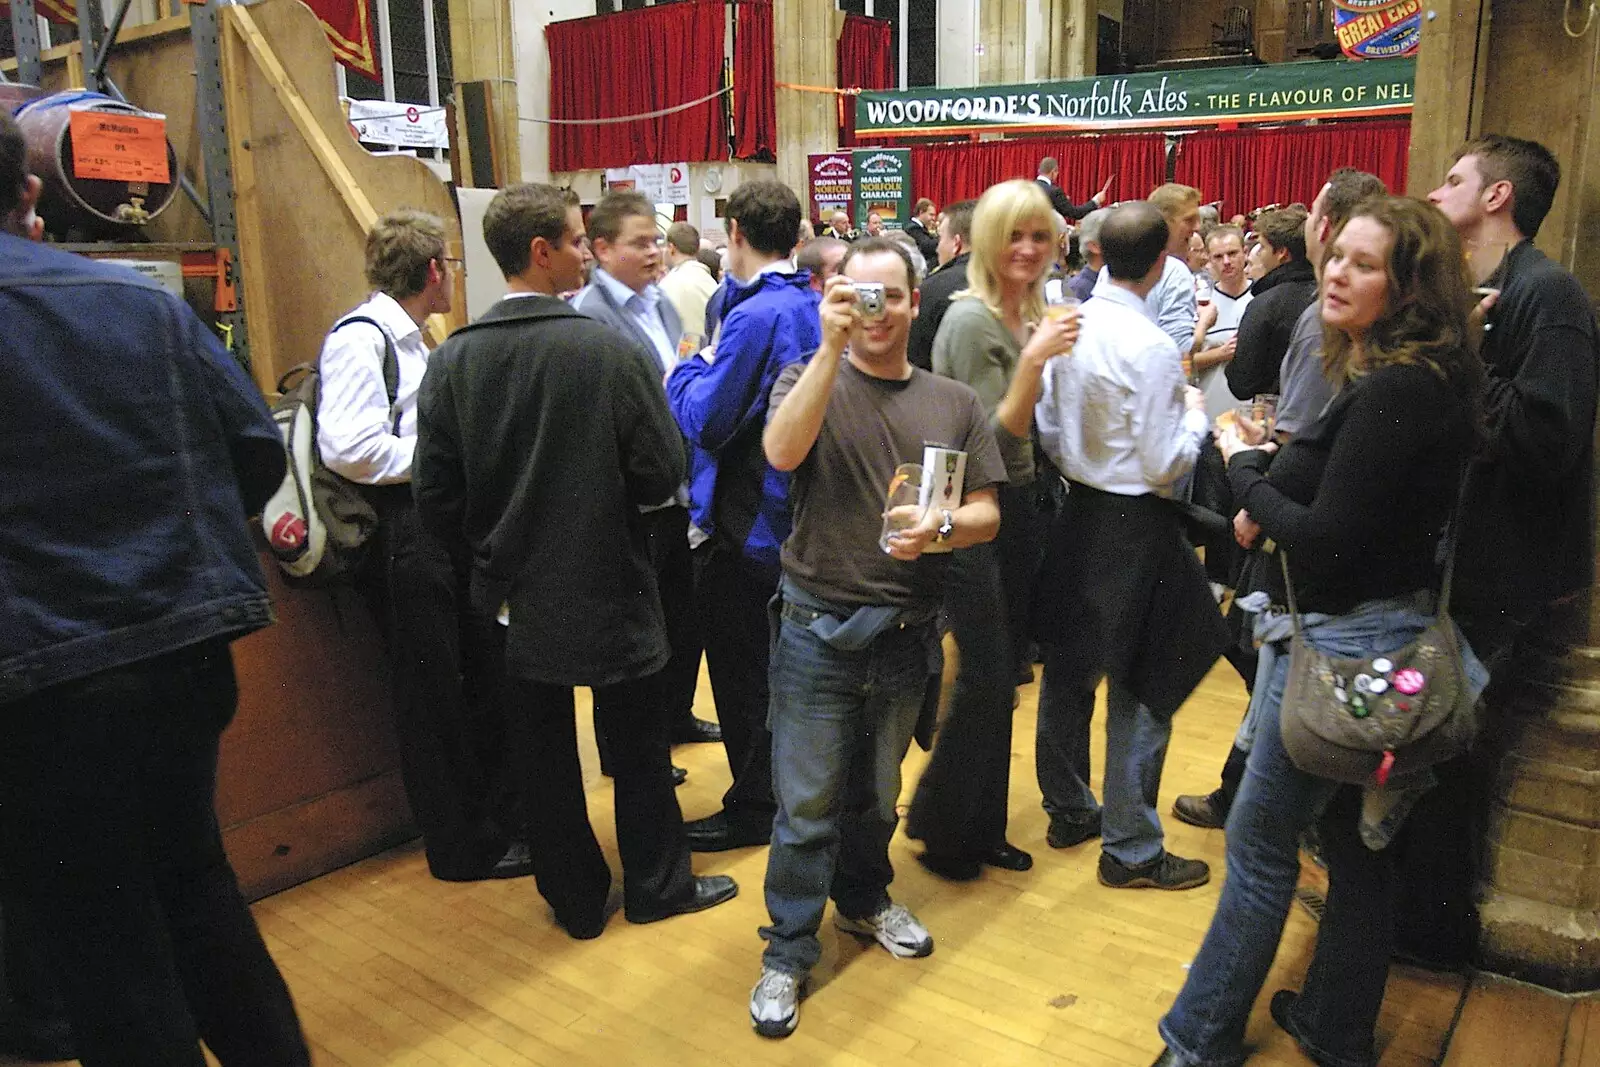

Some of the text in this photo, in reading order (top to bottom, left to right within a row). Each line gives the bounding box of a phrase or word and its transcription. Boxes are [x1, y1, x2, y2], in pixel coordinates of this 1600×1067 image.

[1365, 44, 1400, 55] BREWED
[1401, 40, 1411, 50] IN
[867, 93, 1041, 124] WOODFORDE'S
[1046, 78, 1133, 122] Norfolk
[1137, 76, 1188, 114] Ales
[1207, 93, 1240, 109] THE
[1248, 87, 1333, 108] FLAVOUR
[1341, 85, 1366, 102] OF
[860, 153, 903, 169] Woodforde's
[814, 178, 837, 186] GROWN
[860, 175, 903, 184] MADE WITH
[814, 185, 852, 193] NORFOLK
[860, 182, 902, 191] NORFOLK
[814, 193, 852, 201] CHARACTER
[860, 190, 903, 199] CHARACTER
